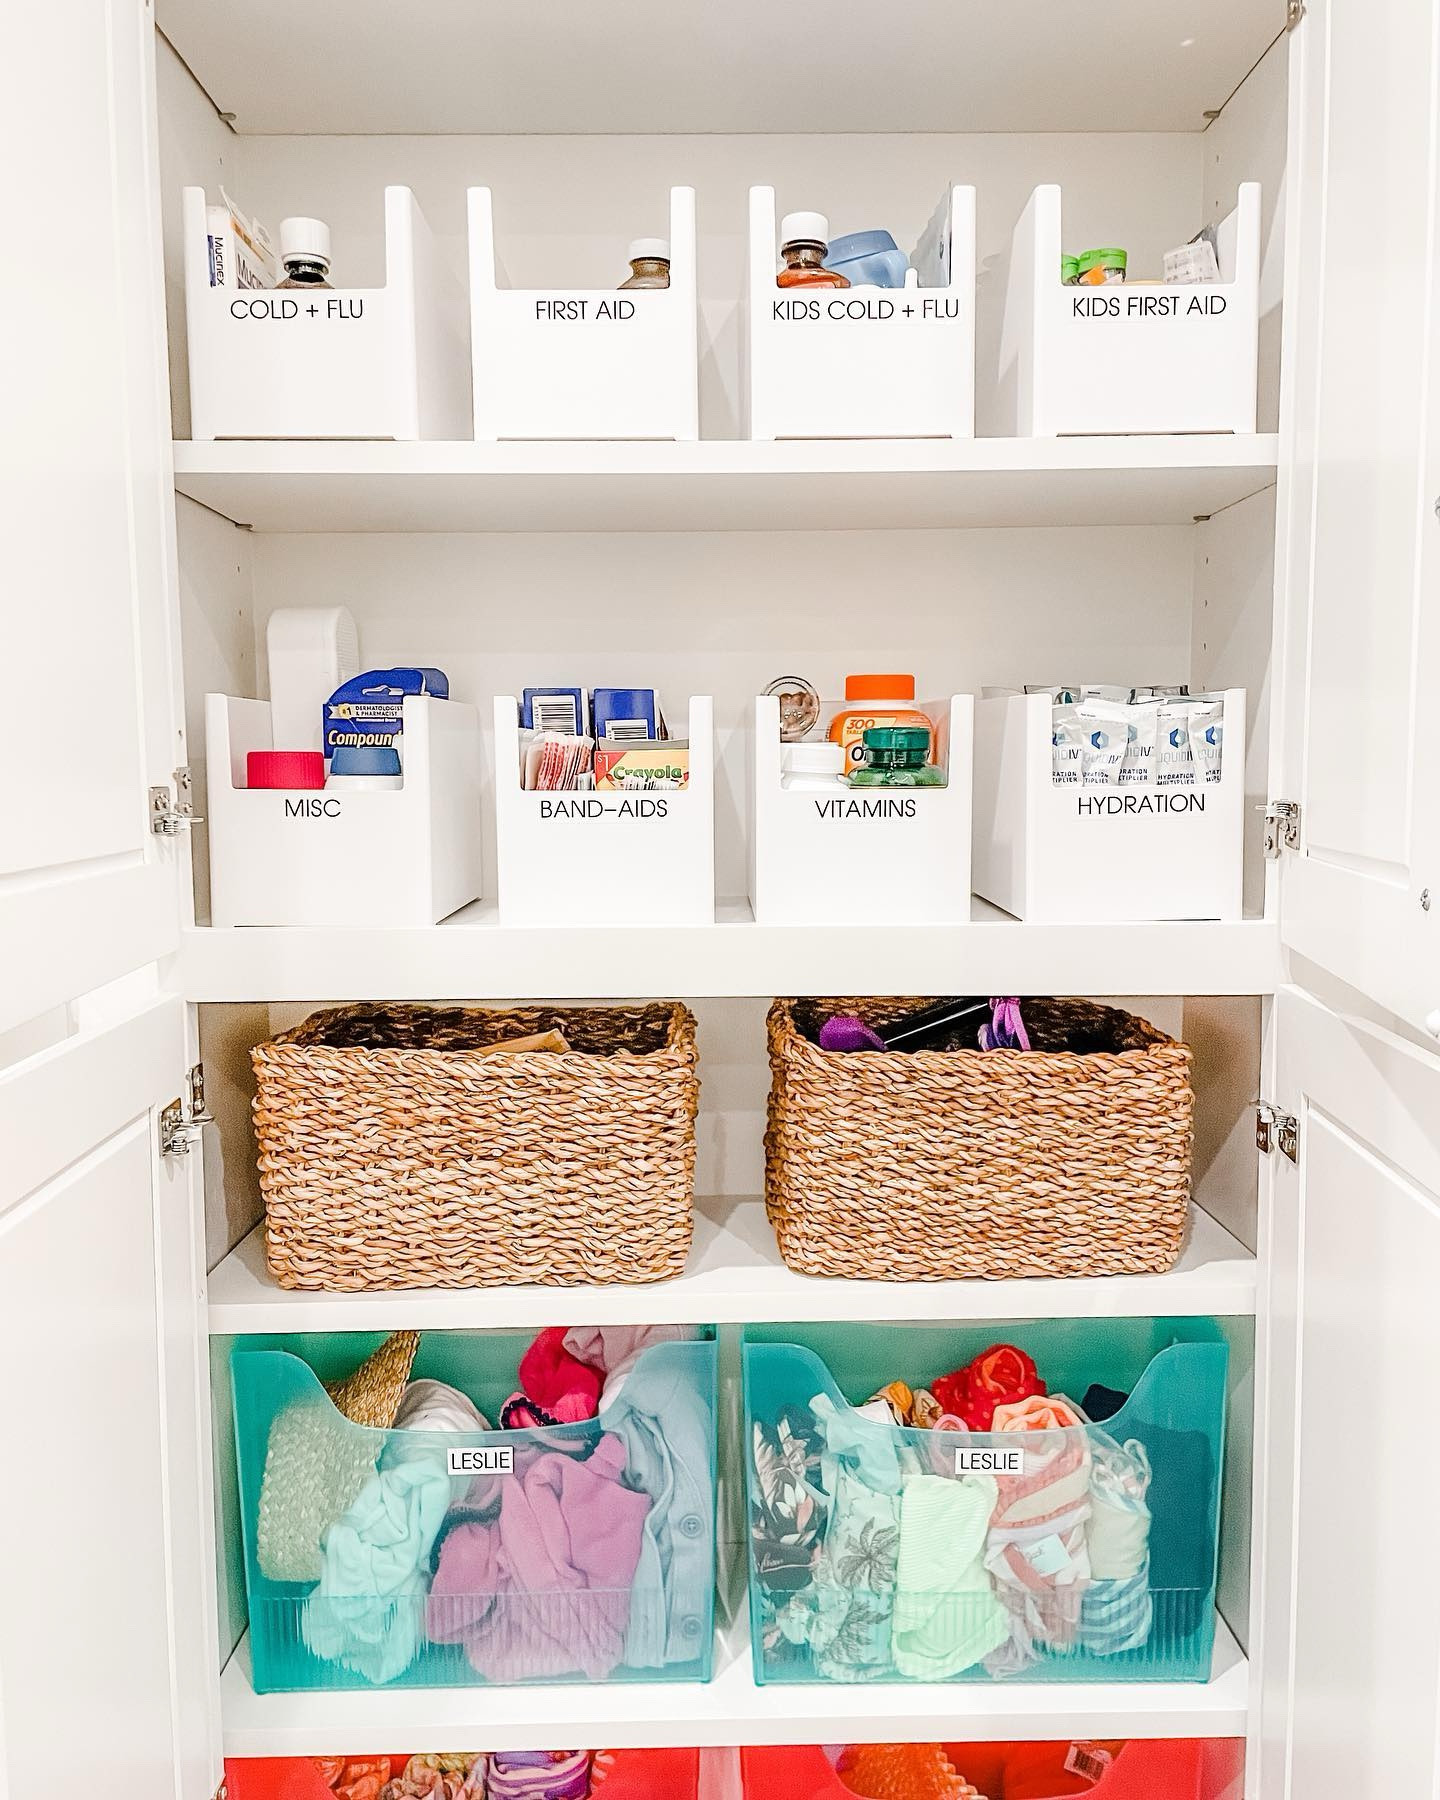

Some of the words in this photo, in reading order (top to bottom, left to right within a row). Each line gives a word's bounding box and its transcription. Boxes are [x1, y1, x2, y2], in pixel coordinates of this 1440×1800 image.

[214, 237, 225, 286] Mucinex
[230, 299, 298, 319] COLD
[306, 304, 319, 318] +
[327, 299, 363, 319] FLU
[536, 300, 589, 320] FIRST
[595, 300, 635, 320] AID
[773, 300, 821, 321] KIDS
[827, 299, 895, 320] COLD
[901, 304, 915, 318] +
[923, 298, 959, 319] FLU
[1073, 296, 1120, 317] KIDS
[1127, 296, 1181, 317] FIRST
[1186, 295, 1227, 316] AID
[847, 719, 876, 729] 300
[328, 729, 402, 748] Compoun
[613, 765, 683, 782] Crayola
[284, 798, 342, 818] MISC
[814, 798, 916, 818] VITAMINS
[1078, 793, 1205, 816] HYDRATION
[450, 1451, 510, 1470] LESLIE
[959, 1452, 1019, 1470] LESLIE
